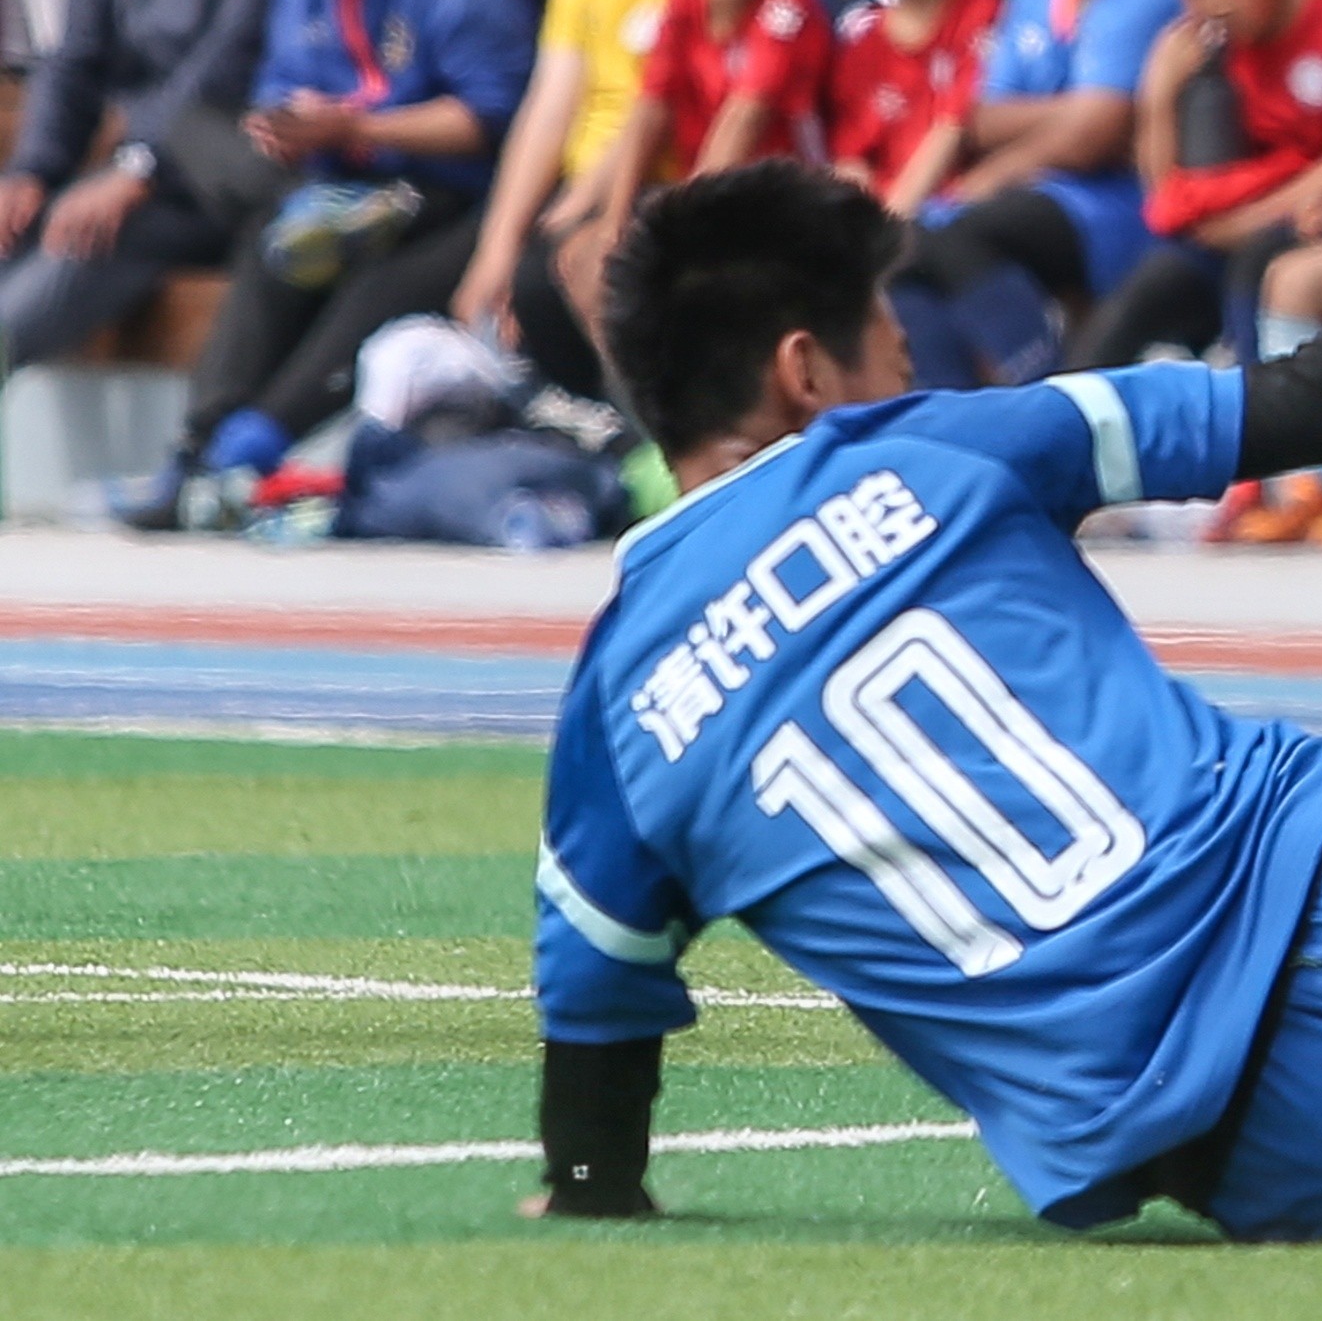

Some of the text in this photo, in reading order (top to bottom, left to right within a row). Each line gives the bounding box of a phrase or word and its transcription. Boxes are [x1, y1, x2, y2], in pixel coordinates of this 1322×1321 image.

[629, 468, 939, 764] 清许口腔
[751, 607, 1146, 978] 10
